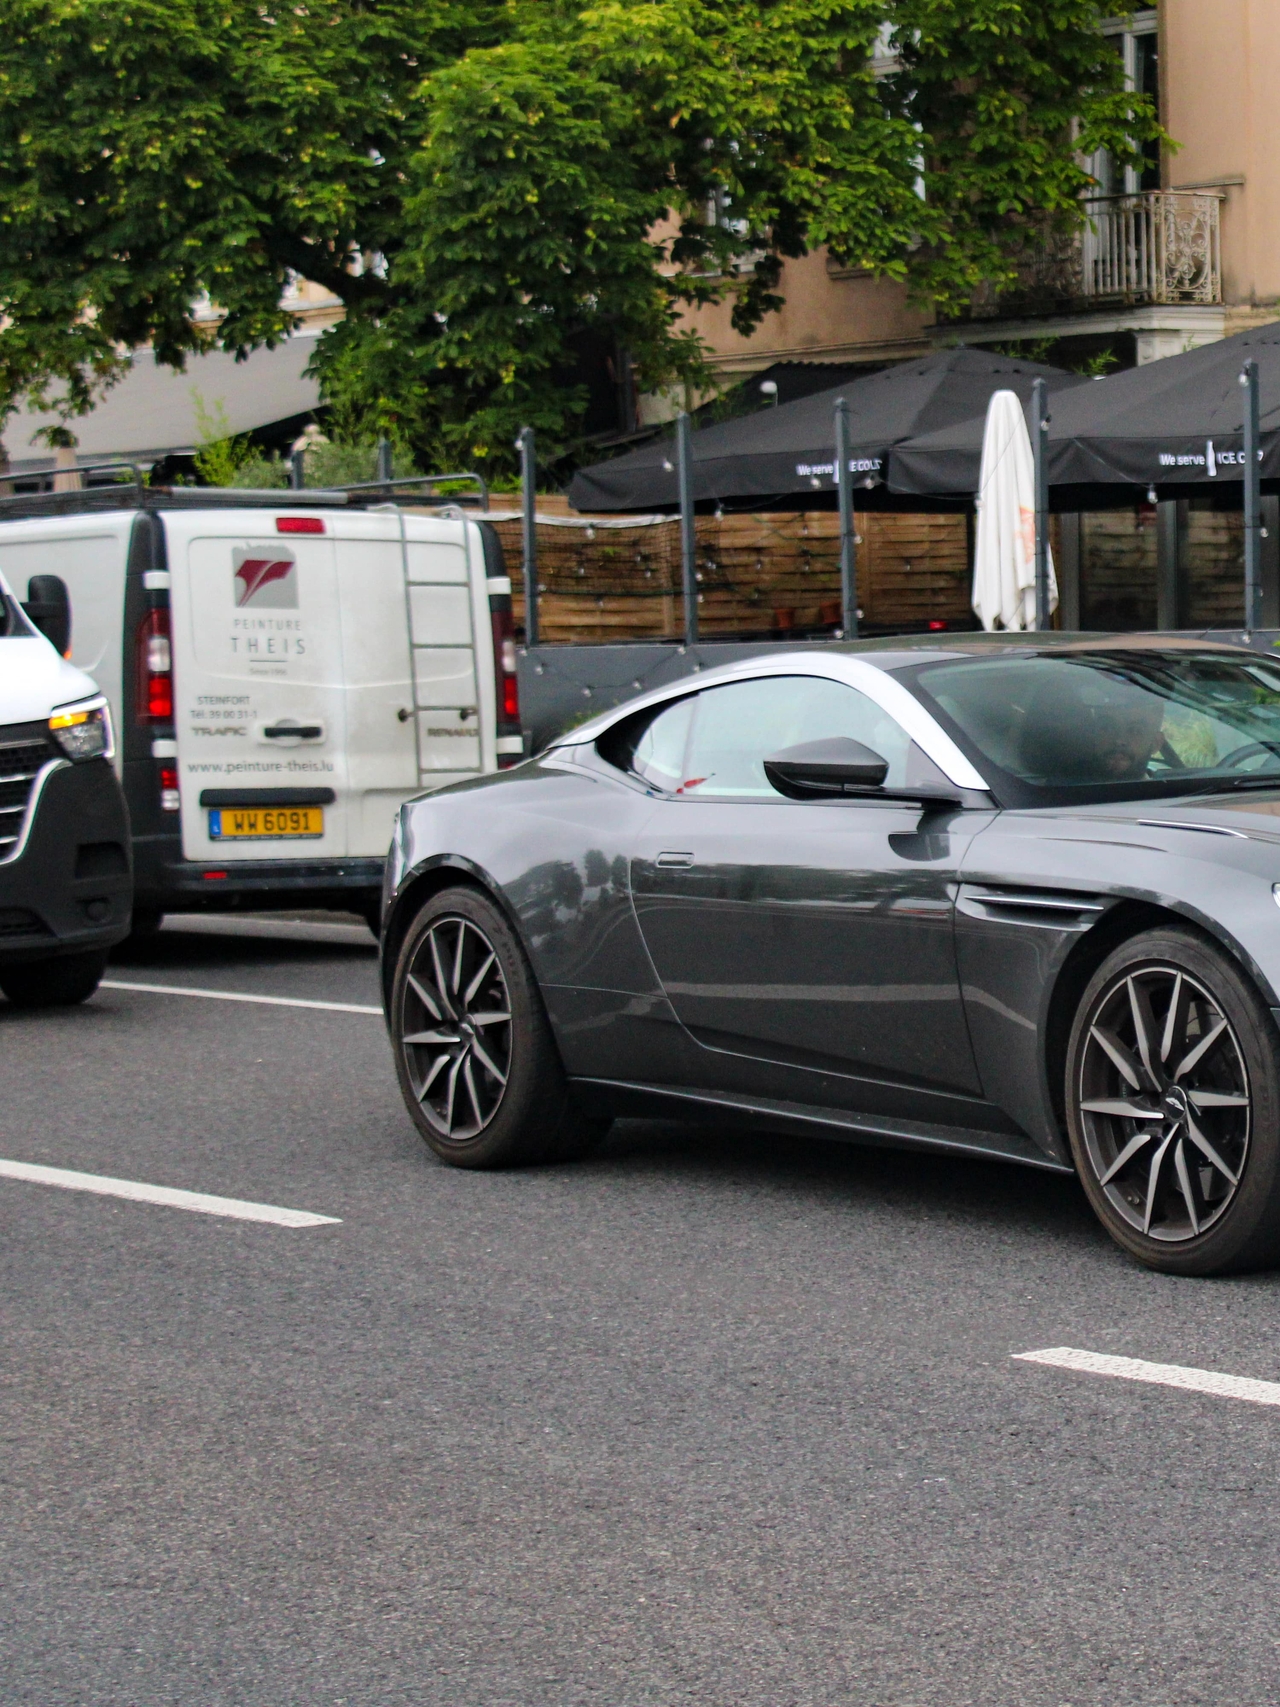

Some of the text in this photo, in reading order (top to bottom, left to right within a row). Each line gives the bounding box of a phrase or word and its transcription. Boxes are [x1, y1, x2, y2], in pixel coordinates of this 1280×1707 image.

[1159, 453, 1176, 466] We
[1176, 454, 1206, 466] serve
[1217, 452, 1237, 464] ICE
[796, 463, 811, 476] We
[811, 463, 834, 475] serve
[234, 618, 301, 631] PEINTURE
[230, 636, 306, 655] THEIS
[197, 696, 251, 706] STEINFORT
[209, 710, 221, 719] 39
[238, 710, 257, 719] 31-1
[191, 726, 247, 737] TRAFIC
[187, 759, 334, 775] www.peinture-theis.lu
[233, 812, 259, 832] WW
[263, 811, 310, 832] 6091
